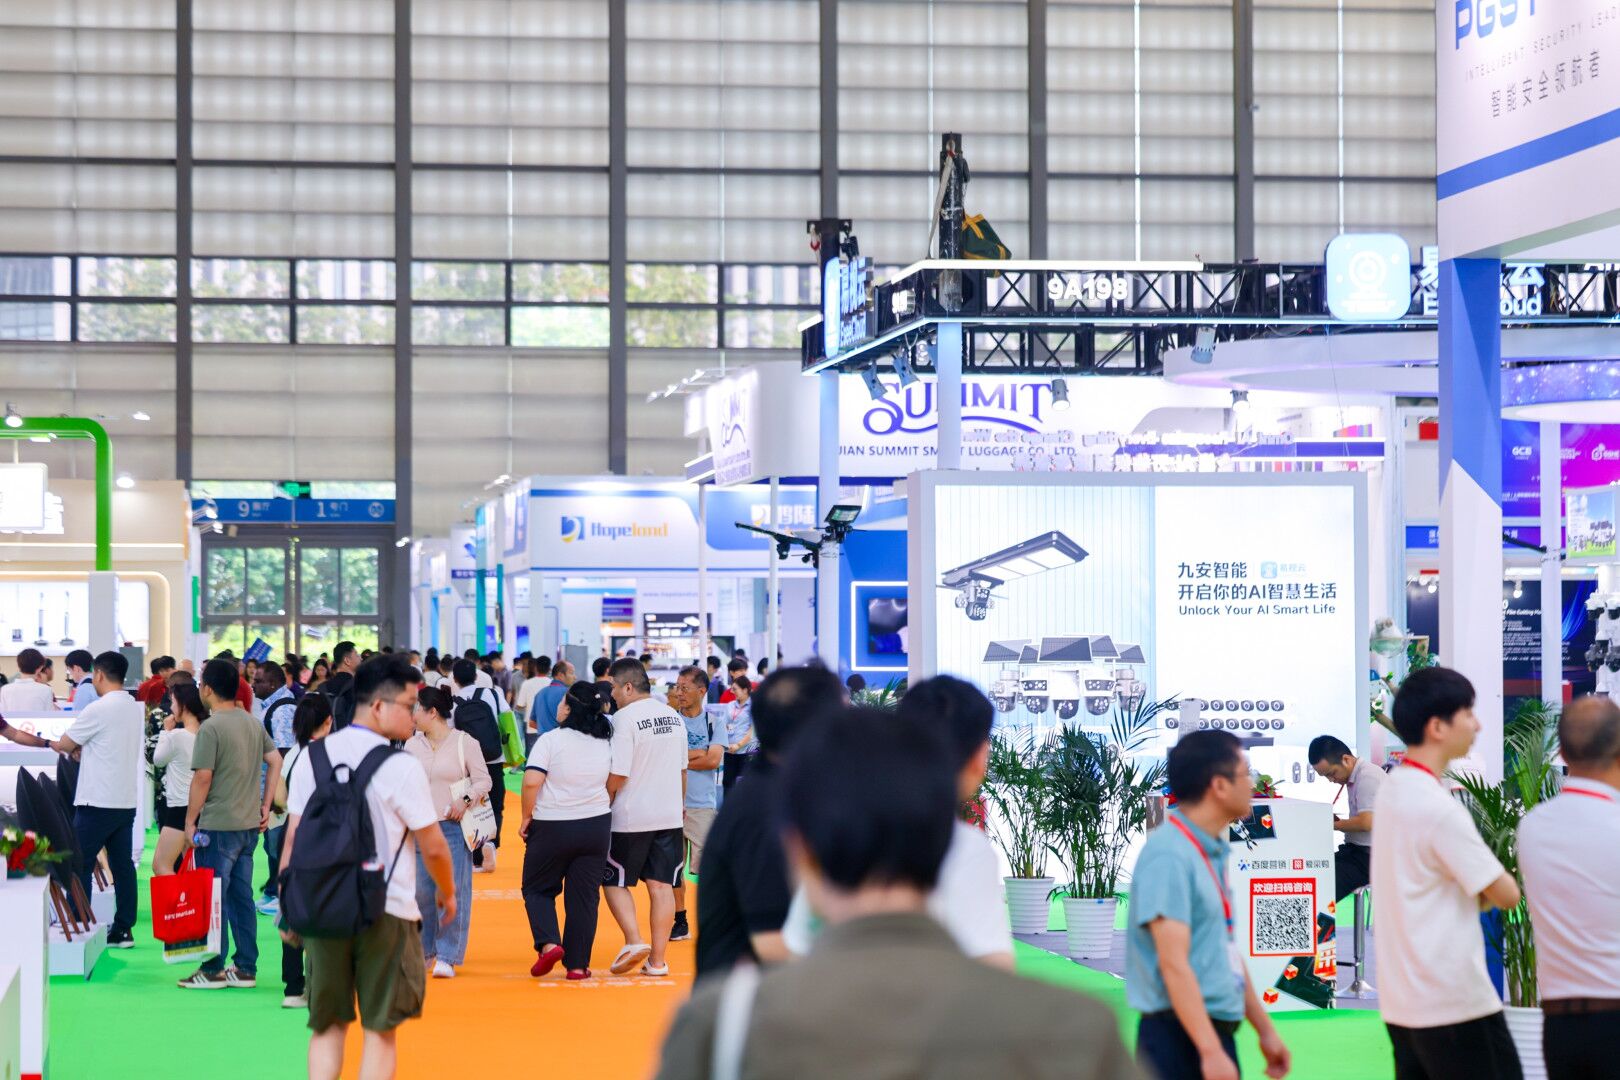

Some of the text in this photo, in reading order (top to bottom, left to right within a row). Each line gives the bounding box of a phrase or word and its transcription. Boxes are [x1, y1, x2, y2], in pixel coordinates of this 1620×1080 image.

[1491, 49, 1600, 118] 智能安全领航者
[1048, 277, 1128, 300] 9A198
[869, 446, 918, 456] SUMMIT
[238, 501, 250, 517] 9
[316, 502, 327, 518] 1
[591, 522, 669, 540] Hopeland
[1178, 561, 1247, 579] 九安智能
[1178, 582, 1337, 600] 开启你的AI智慧生活
[1179, 603, 1336, 615] Unlock Your AI Smart Life
[637, 716, 681, 731] LOS ANGELES
[652, 726, 673, 735] LAKERS
[1251, 860, 1287, 870] 百度营销
[1253, 882, 1313, 893] 欢迎扫码咨询
